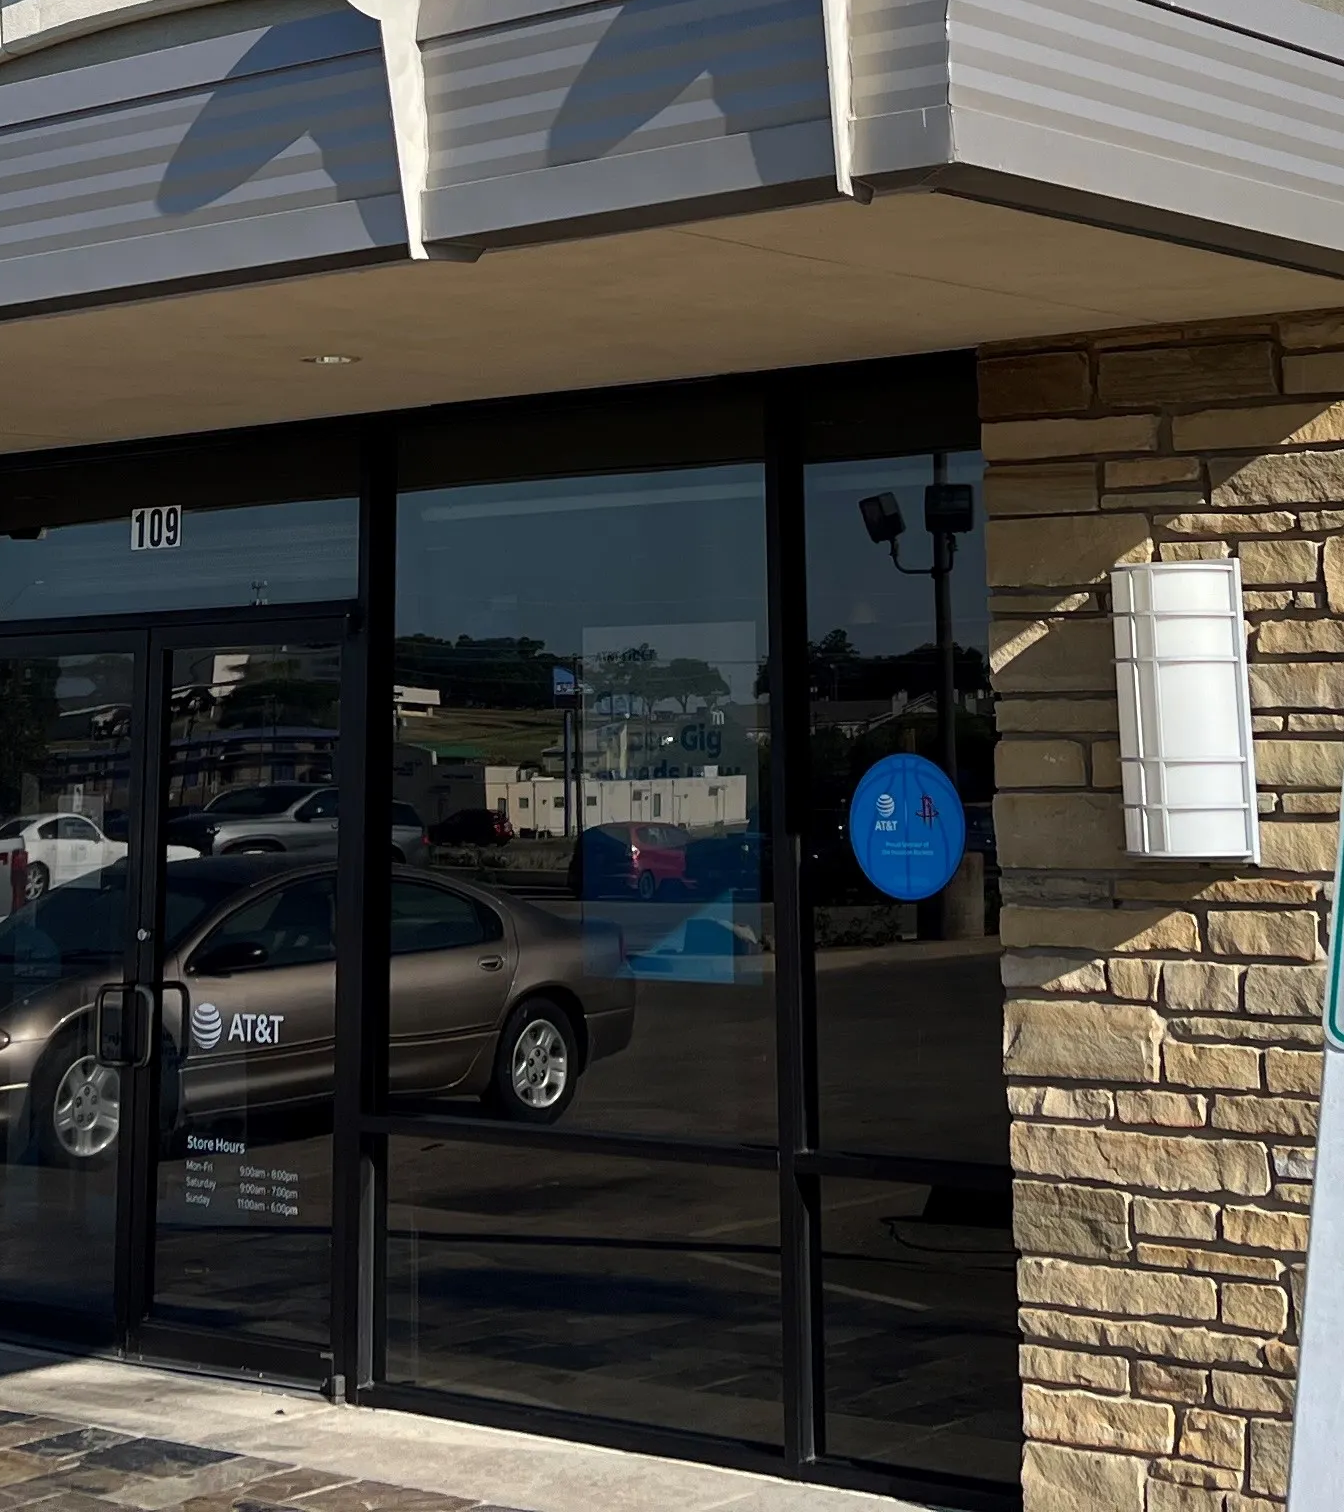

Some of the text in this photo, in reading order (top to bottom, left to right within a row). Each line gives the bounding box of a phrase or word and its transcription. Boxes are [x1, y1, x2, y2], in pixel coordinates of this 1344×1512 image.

[135, 507, 179, 548] 109
[874, 820, 898, 832] AT&T
[228, 1013, 285, 1044] AT&T
[187, 1135, 246, 1155] Store Hours
[185, 1159, 214, 1173] Mon-Fri
[185, 1176, 216, 1192] Saturday
[185, 1191, 211, 1207] Sunday
